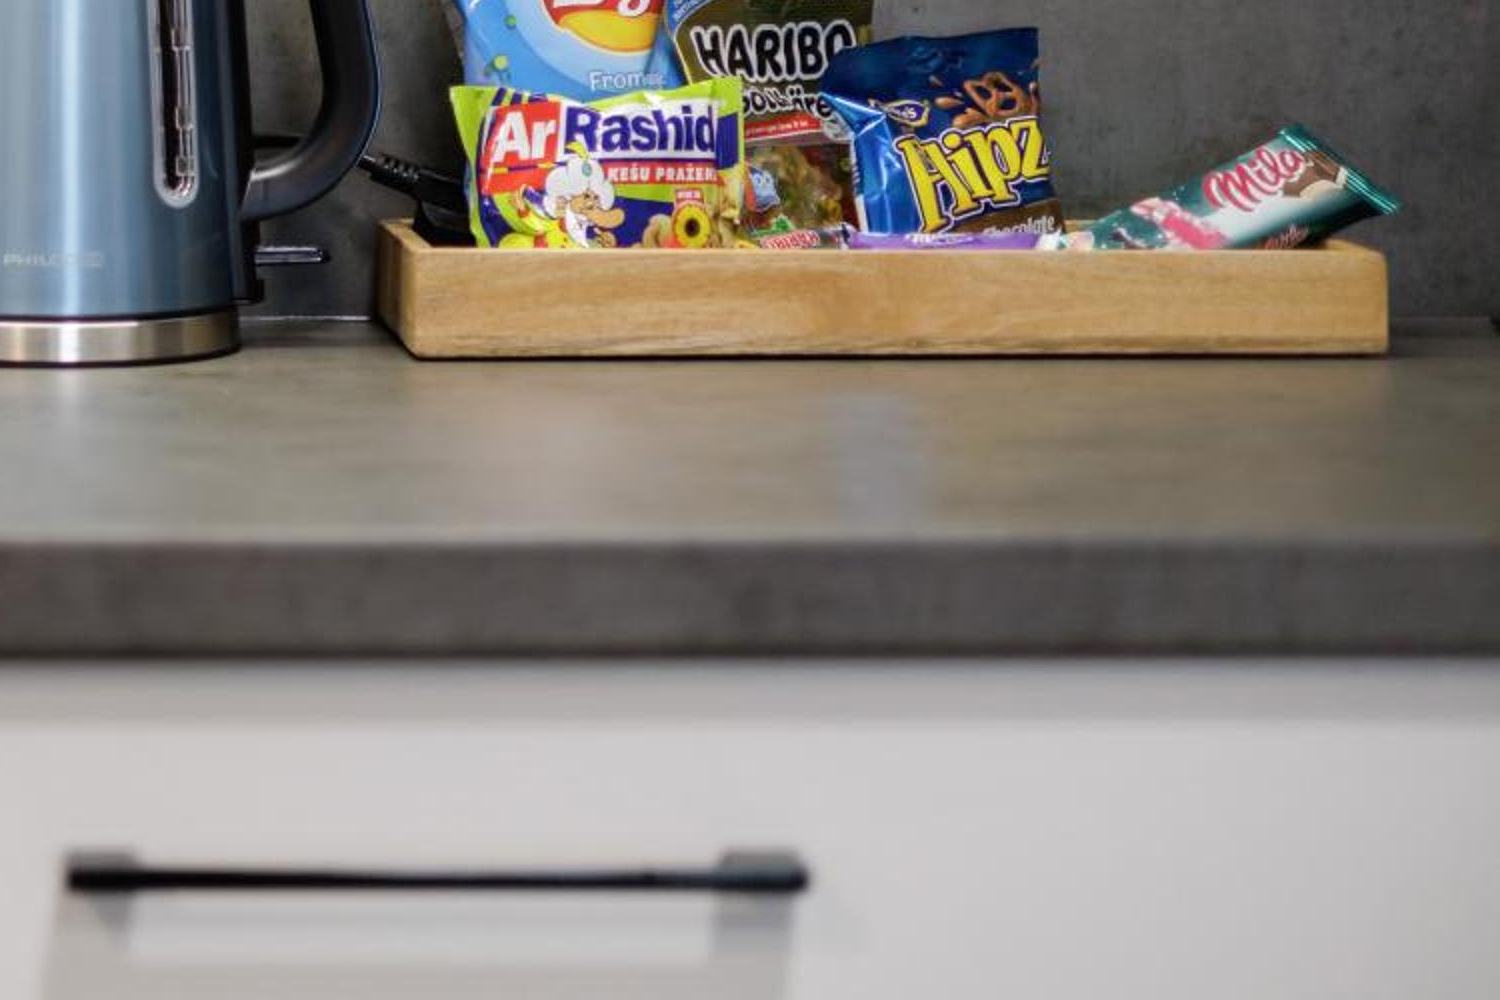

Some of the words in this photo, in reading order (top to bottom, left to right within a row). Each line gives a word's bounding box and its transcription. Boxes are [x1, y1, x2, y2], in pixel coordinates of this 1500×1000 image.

[588, 71, 667, 92] From
[655, 163, 717, 181] PRAŽEN
[1203, 145, 1304, 212] Mila
